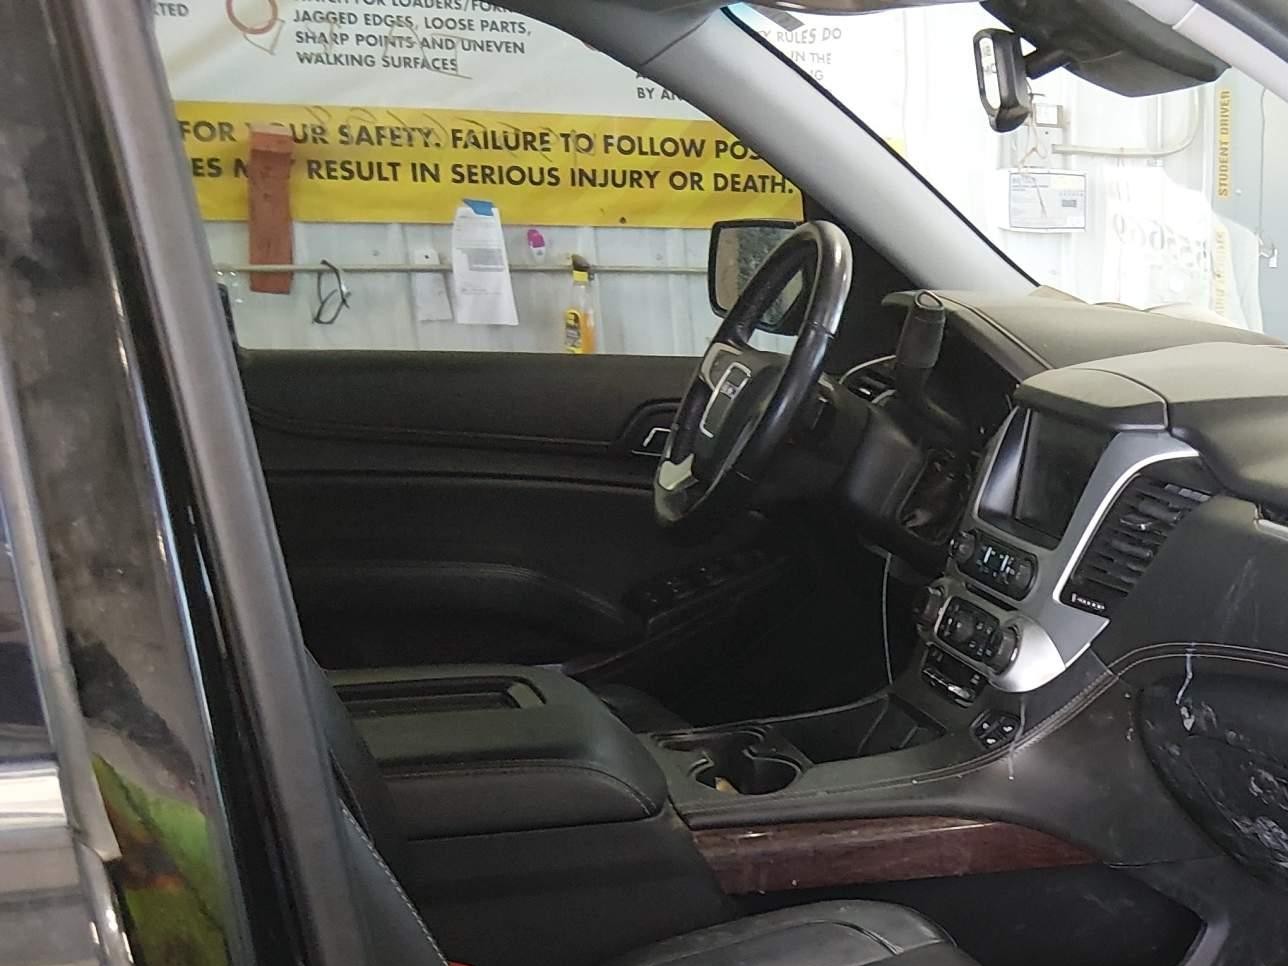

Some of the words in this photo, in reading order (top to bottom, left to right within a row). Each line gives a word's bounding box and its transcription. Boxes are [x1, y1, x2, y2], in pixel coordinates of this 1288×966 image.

[293, 10, 358, 25] JAGGED
[363, 13, 418, 31] EDGES,
[424, 16, 475, 31] LOOSE
[480, 19, 531, 36] PARTS,
[295, 31, 349, 45] SHARP
[355, 33, 414, 49] POINTS
[420, 37, 456, 51] AND
[461, 39, 526, 54] UNEVEN
[776, 28, 817, 44] RULES
[822, 27, 842, 41] DO
[296, 51, 376, 68] WALKING
[381, 55, 458, 72] SURFACES
[809, 51, 832, 65] THE
[637, 87, 655, 99] BY
[1219, 90, 1232, 136] DRIVER
[337, 124, 441, 148] SAFETY.
[449, 128, 552, 151] FAILURE
[559, 132, 594, 153] TO
[603, 134, 706, 158] FOLLOW
[307, 159, 402, 182] RESULT
[411, 162, 441, 183] IN
[451, 163, 561, 187] SERIOUS
[570, 166, 662, 189] INJURY
[668, 170, 705, 191] OR
[713, 172, 793, 194] DEATH.
[1217, 139, 1229, 197] STUDENT
